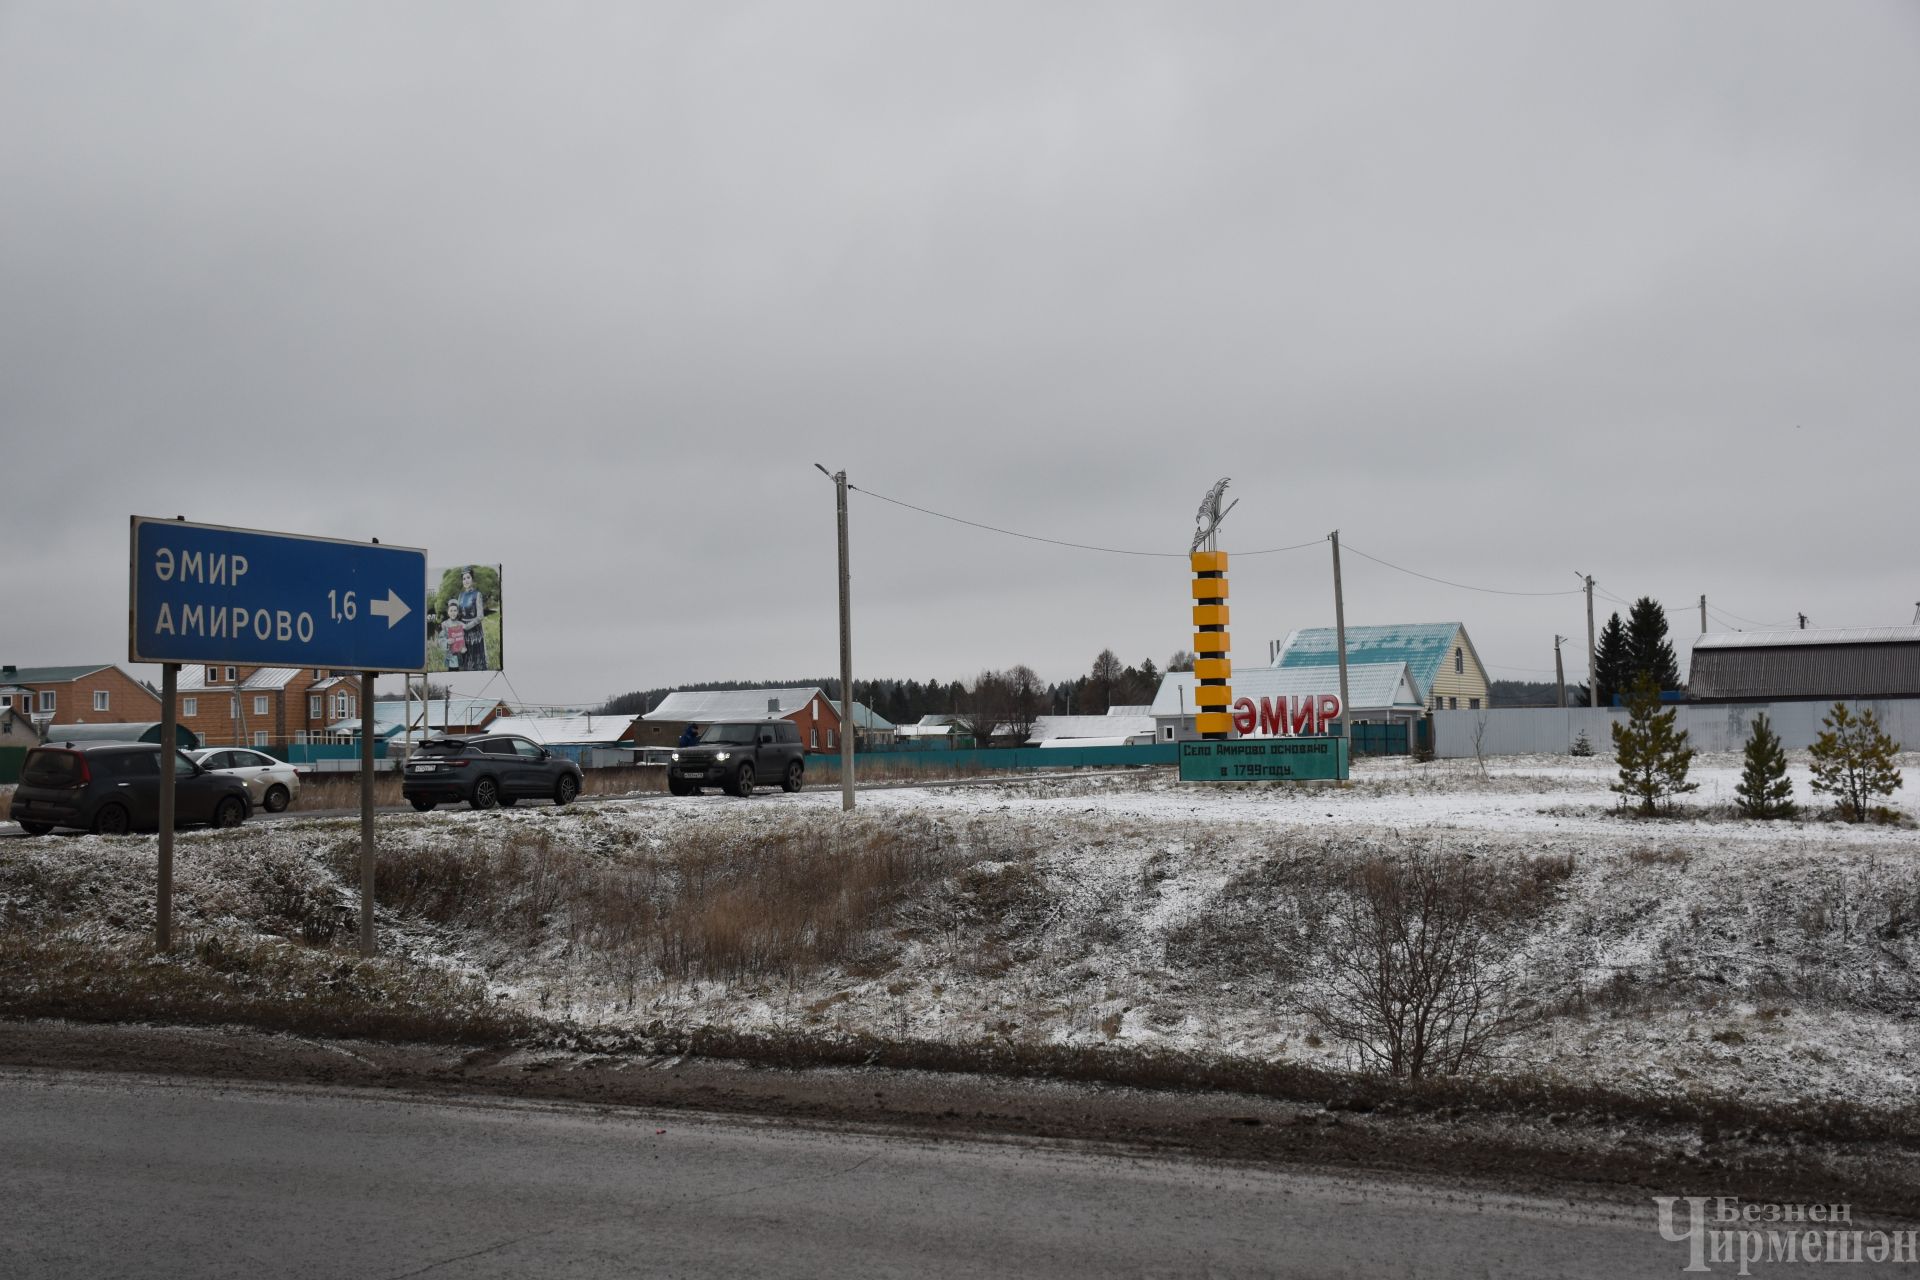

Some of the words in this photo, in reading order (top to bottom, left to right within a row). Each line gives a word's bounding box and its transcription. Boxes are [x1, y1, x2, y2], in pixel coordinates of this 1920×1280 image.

[155, 547, 248, 586] ӘМИР
[154, 602, 314, 643] АМИРОВО
[328, 590, 357, 625] 1,6
[1233, 694, 1342, 735] ӘМИР
[1184, 744, 1211, 756] Село
[1216, 744, 1266, 755] Амирово
[1271, 743, 1328, 754] основано
